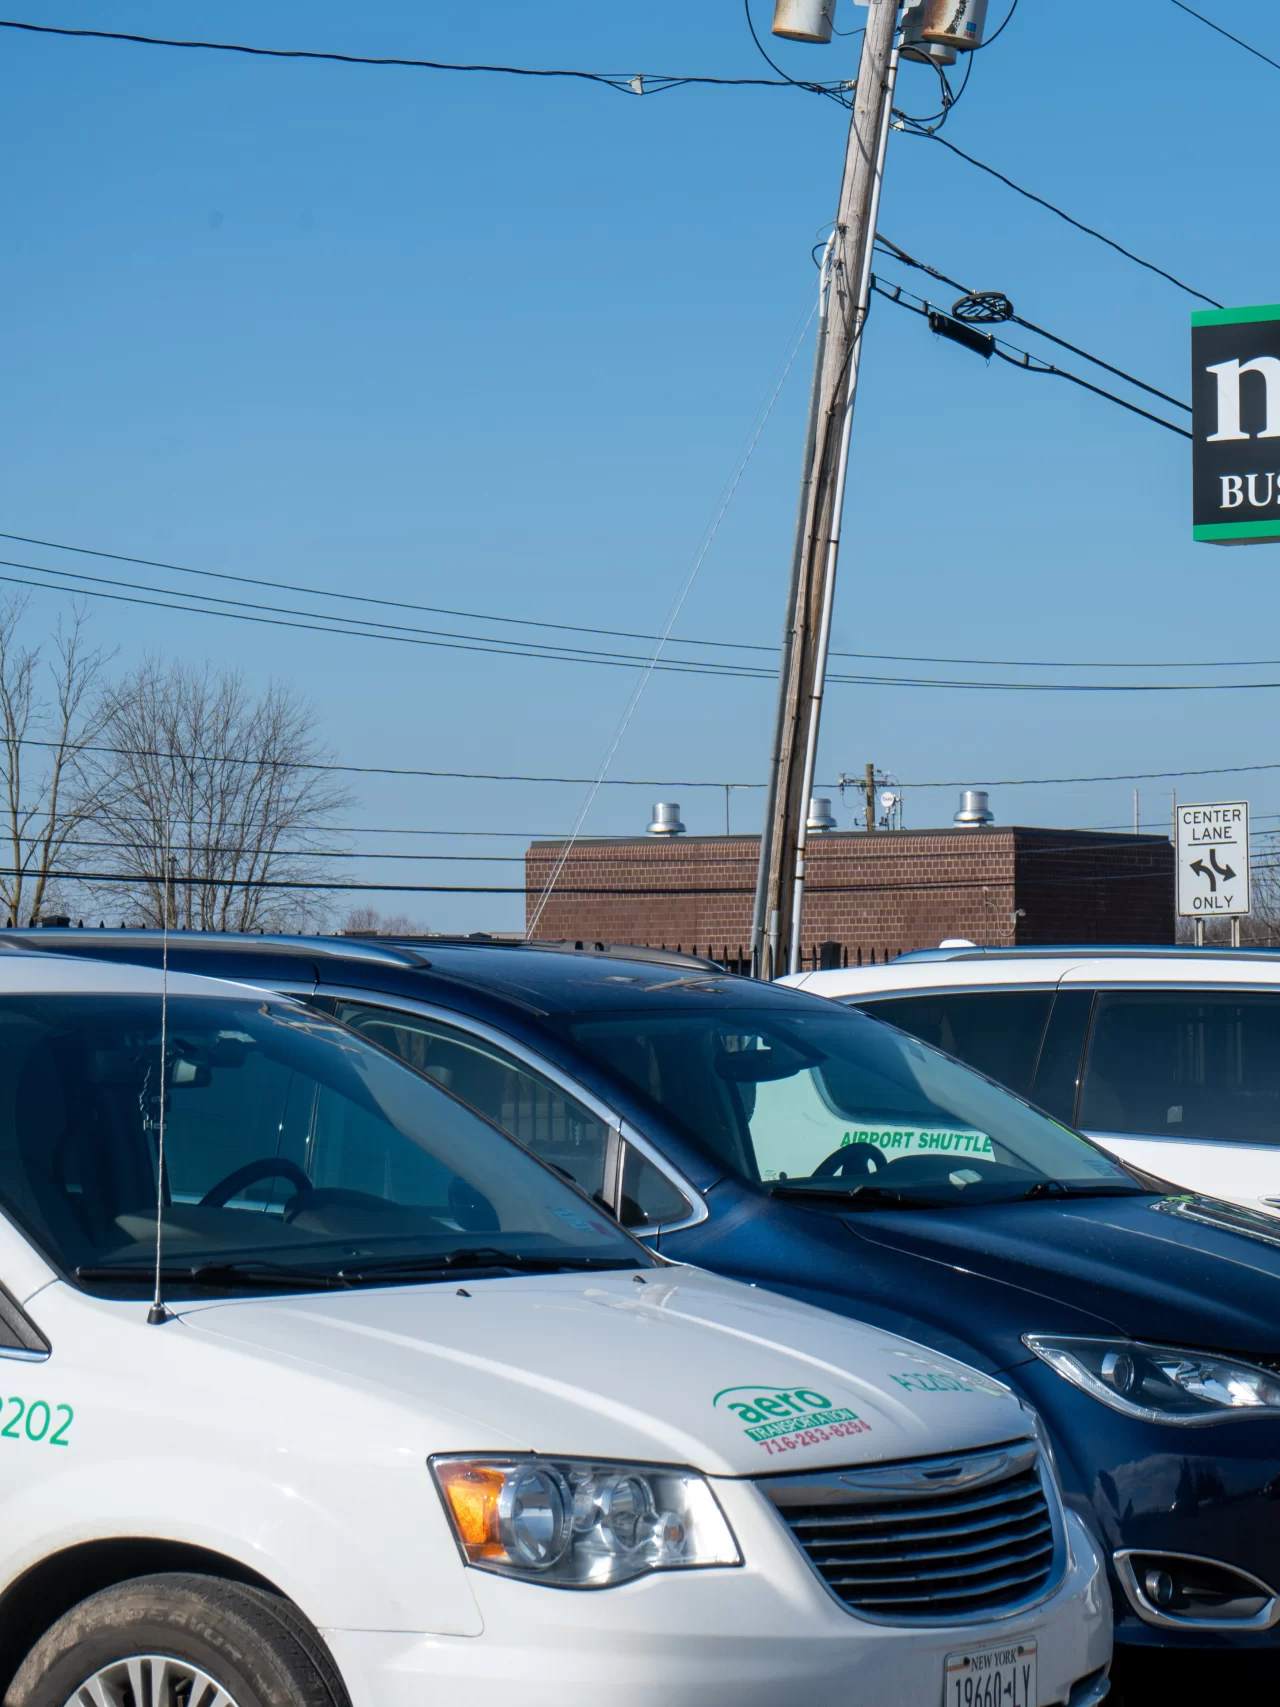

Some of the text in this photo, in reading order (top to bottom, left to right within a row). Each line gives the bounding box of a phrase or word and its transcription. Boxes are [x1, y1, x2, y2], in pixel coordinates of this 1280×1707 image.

[1183, 809, 1242, 825] CENTER
[1192, 826, 1233, 841] LANE
[1193, 895, 1234, 910] ONLY
[840, 1131, 992, 1153] AIRPORT SHUTTLE
[728, 1388, 833, 1424] aero
[0, 1396, 74, 1447] 202
[748, 1407, 854, 1441] TRANSPORTATION
[758, 1419, 873, 1456] 716-283-8294
[970, 1648, 1018, 1673] NEW YORK
